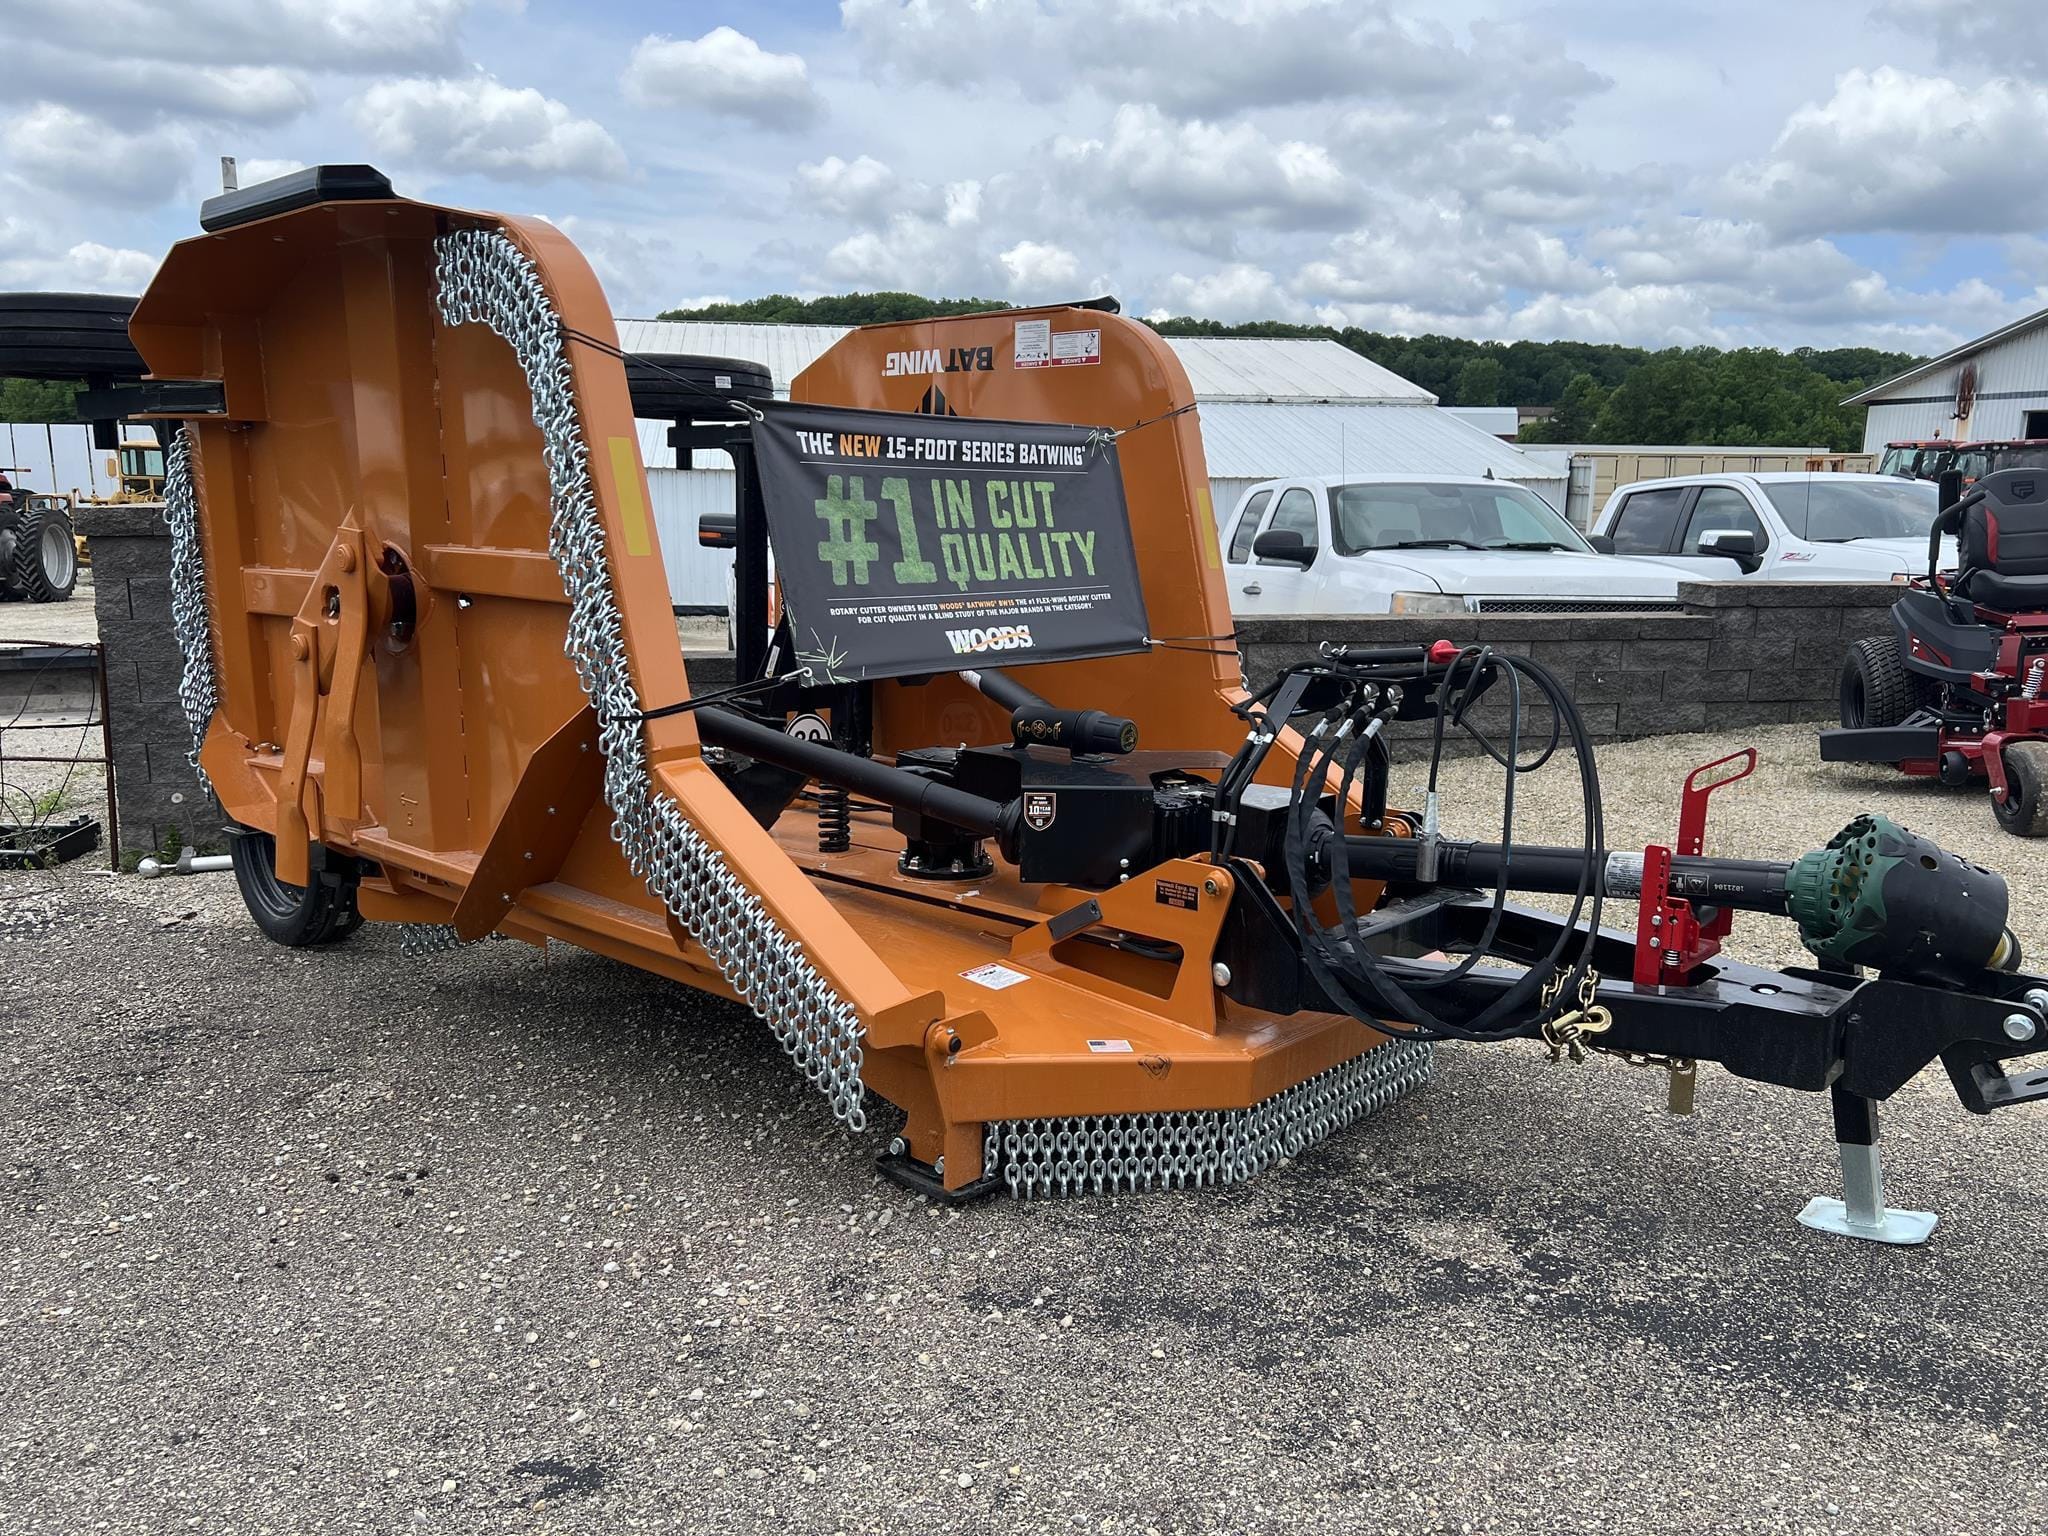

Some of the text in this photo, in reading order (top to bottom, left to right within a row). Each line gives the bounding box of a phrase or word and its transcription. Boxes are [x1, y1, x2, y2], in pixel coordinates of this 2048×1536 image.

[796, 431, 835, 456] THE
[840, 434, 881, 458] NEW
[886, 436, 957, 461] 15-FOOT
[962, 440, 1015, 464] SERIES
[931, 479, 1056, 528] IN CUT
[815, 474, 938, 586] #1
[940, 530, 1096, 592] QUALITY
[830, 607, 858, 616] ROTARY
[860, 606, 886, 614] CUTTER
[888, 604, 916, 614] OWNERS
[918, 604, 938, 612] RATED
[1036, 596, 1068, 604] FLEX-WING
[1068, 594, 1090, 602] ROTARY
[858, 616, 872, 624] FOR
[874, 615, 888, 623] CUT
[888, 614, 917, 624] QUALITY
[934, 612, 954, 620] BLIND
[955, 610, 976, 618] STUDY
[976, 608, 984, 617] OF
[986, 608, 998, 616] THE
[999, 608, 1020, 616] MAJOR
[1020, 606, 1044, 614] BRANDS
[1064, 602, 1094, 610] CATEGORY.
[945, 625, 1034, 654] WOODS
[1028, 806, 1039, 814] 10
